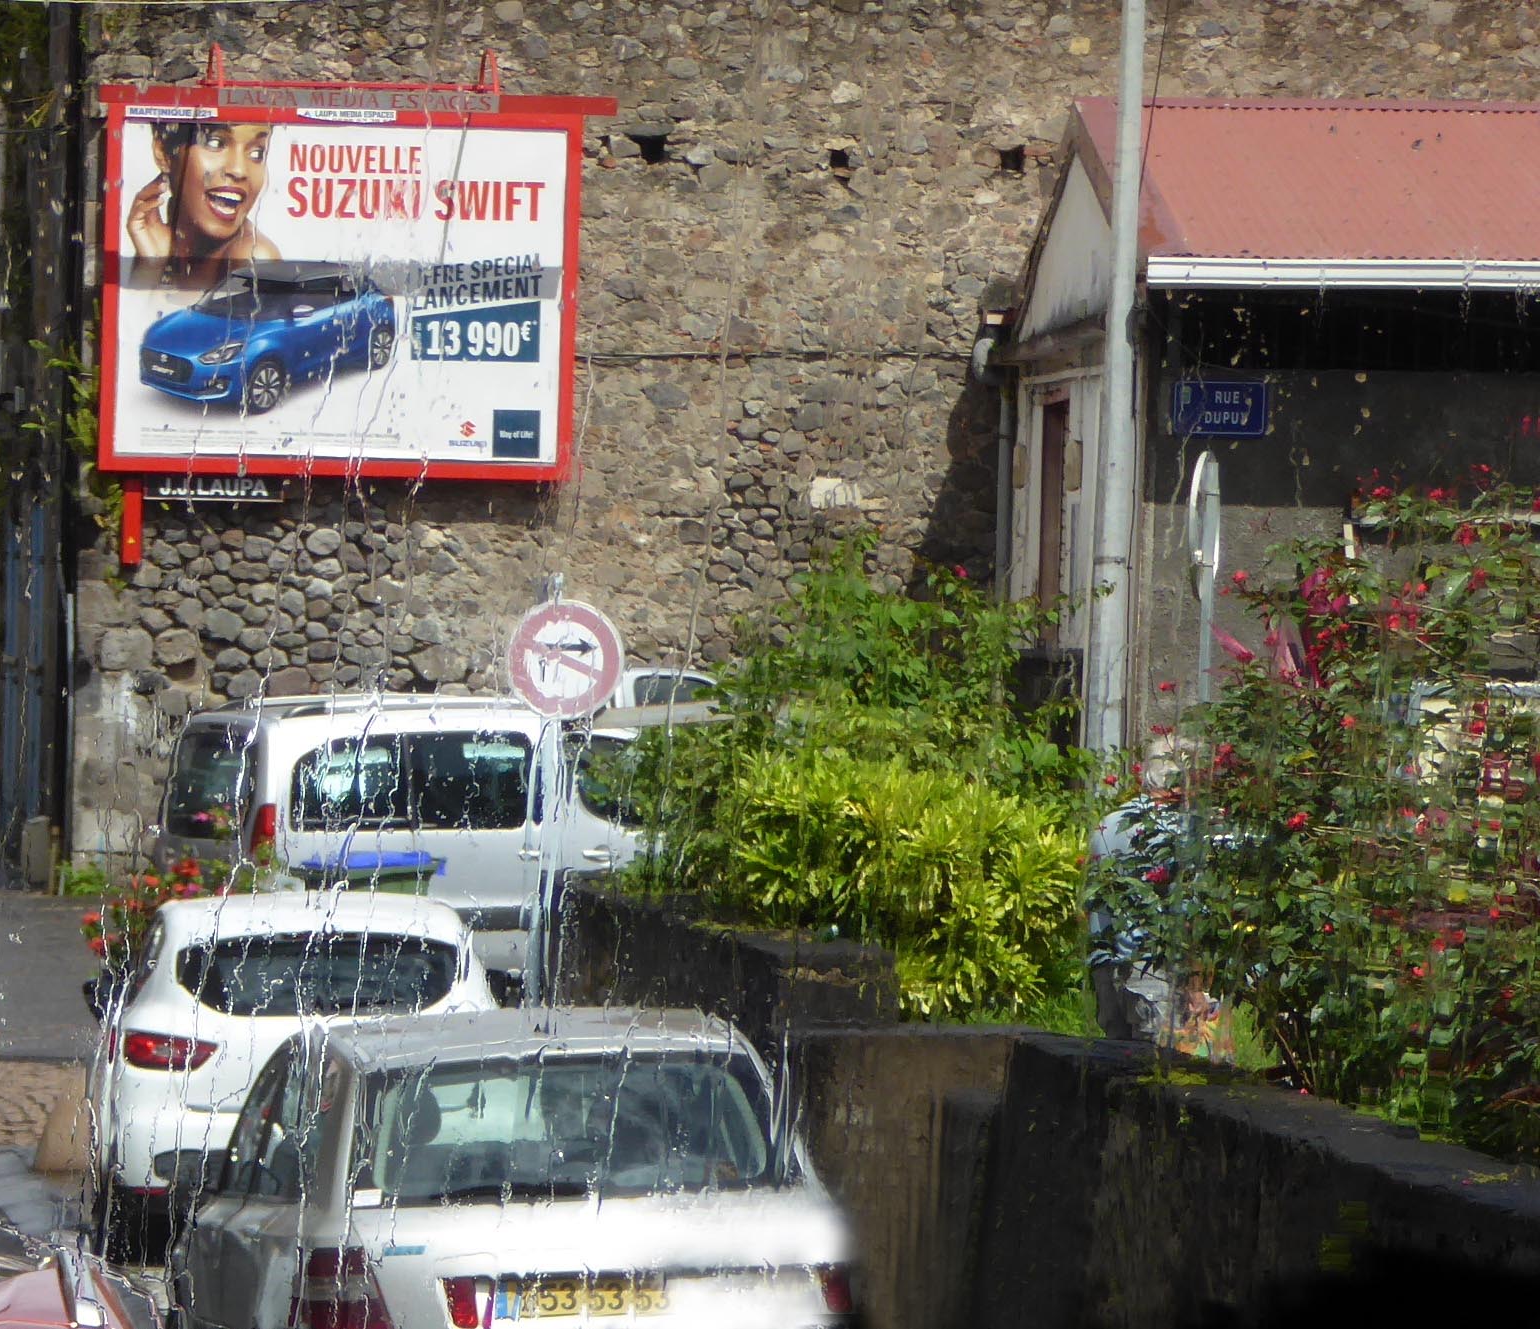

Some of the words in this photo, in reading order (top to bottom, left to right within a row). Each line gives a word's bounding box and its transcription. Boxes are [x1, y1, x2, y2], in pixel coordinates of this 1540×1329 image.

[309, 91, 379, 108] MEDIA
[390, 93, 492, 111] ESPACES
[129, 107, 192, 117] MARTINIQUE
[316, 110, 338, 118] LAUPA
[340, 110, 362, 118] MEDIA
[364, 111, 394, 119] ESPACES
[290, 143, 422, 174] NOUVELLE
[287, 176, 421, 220] SUZUKI
[434, 179, 546, 221] SWIFT
[412, 275, 543, 311] LANCEMENT
[426, 320, 461, 355] 13
[1215, 391, 1240, 404] RUE
[1204, 411, 1247, 425] DUPUY
[196, 478, 269, 496] LAUPA
